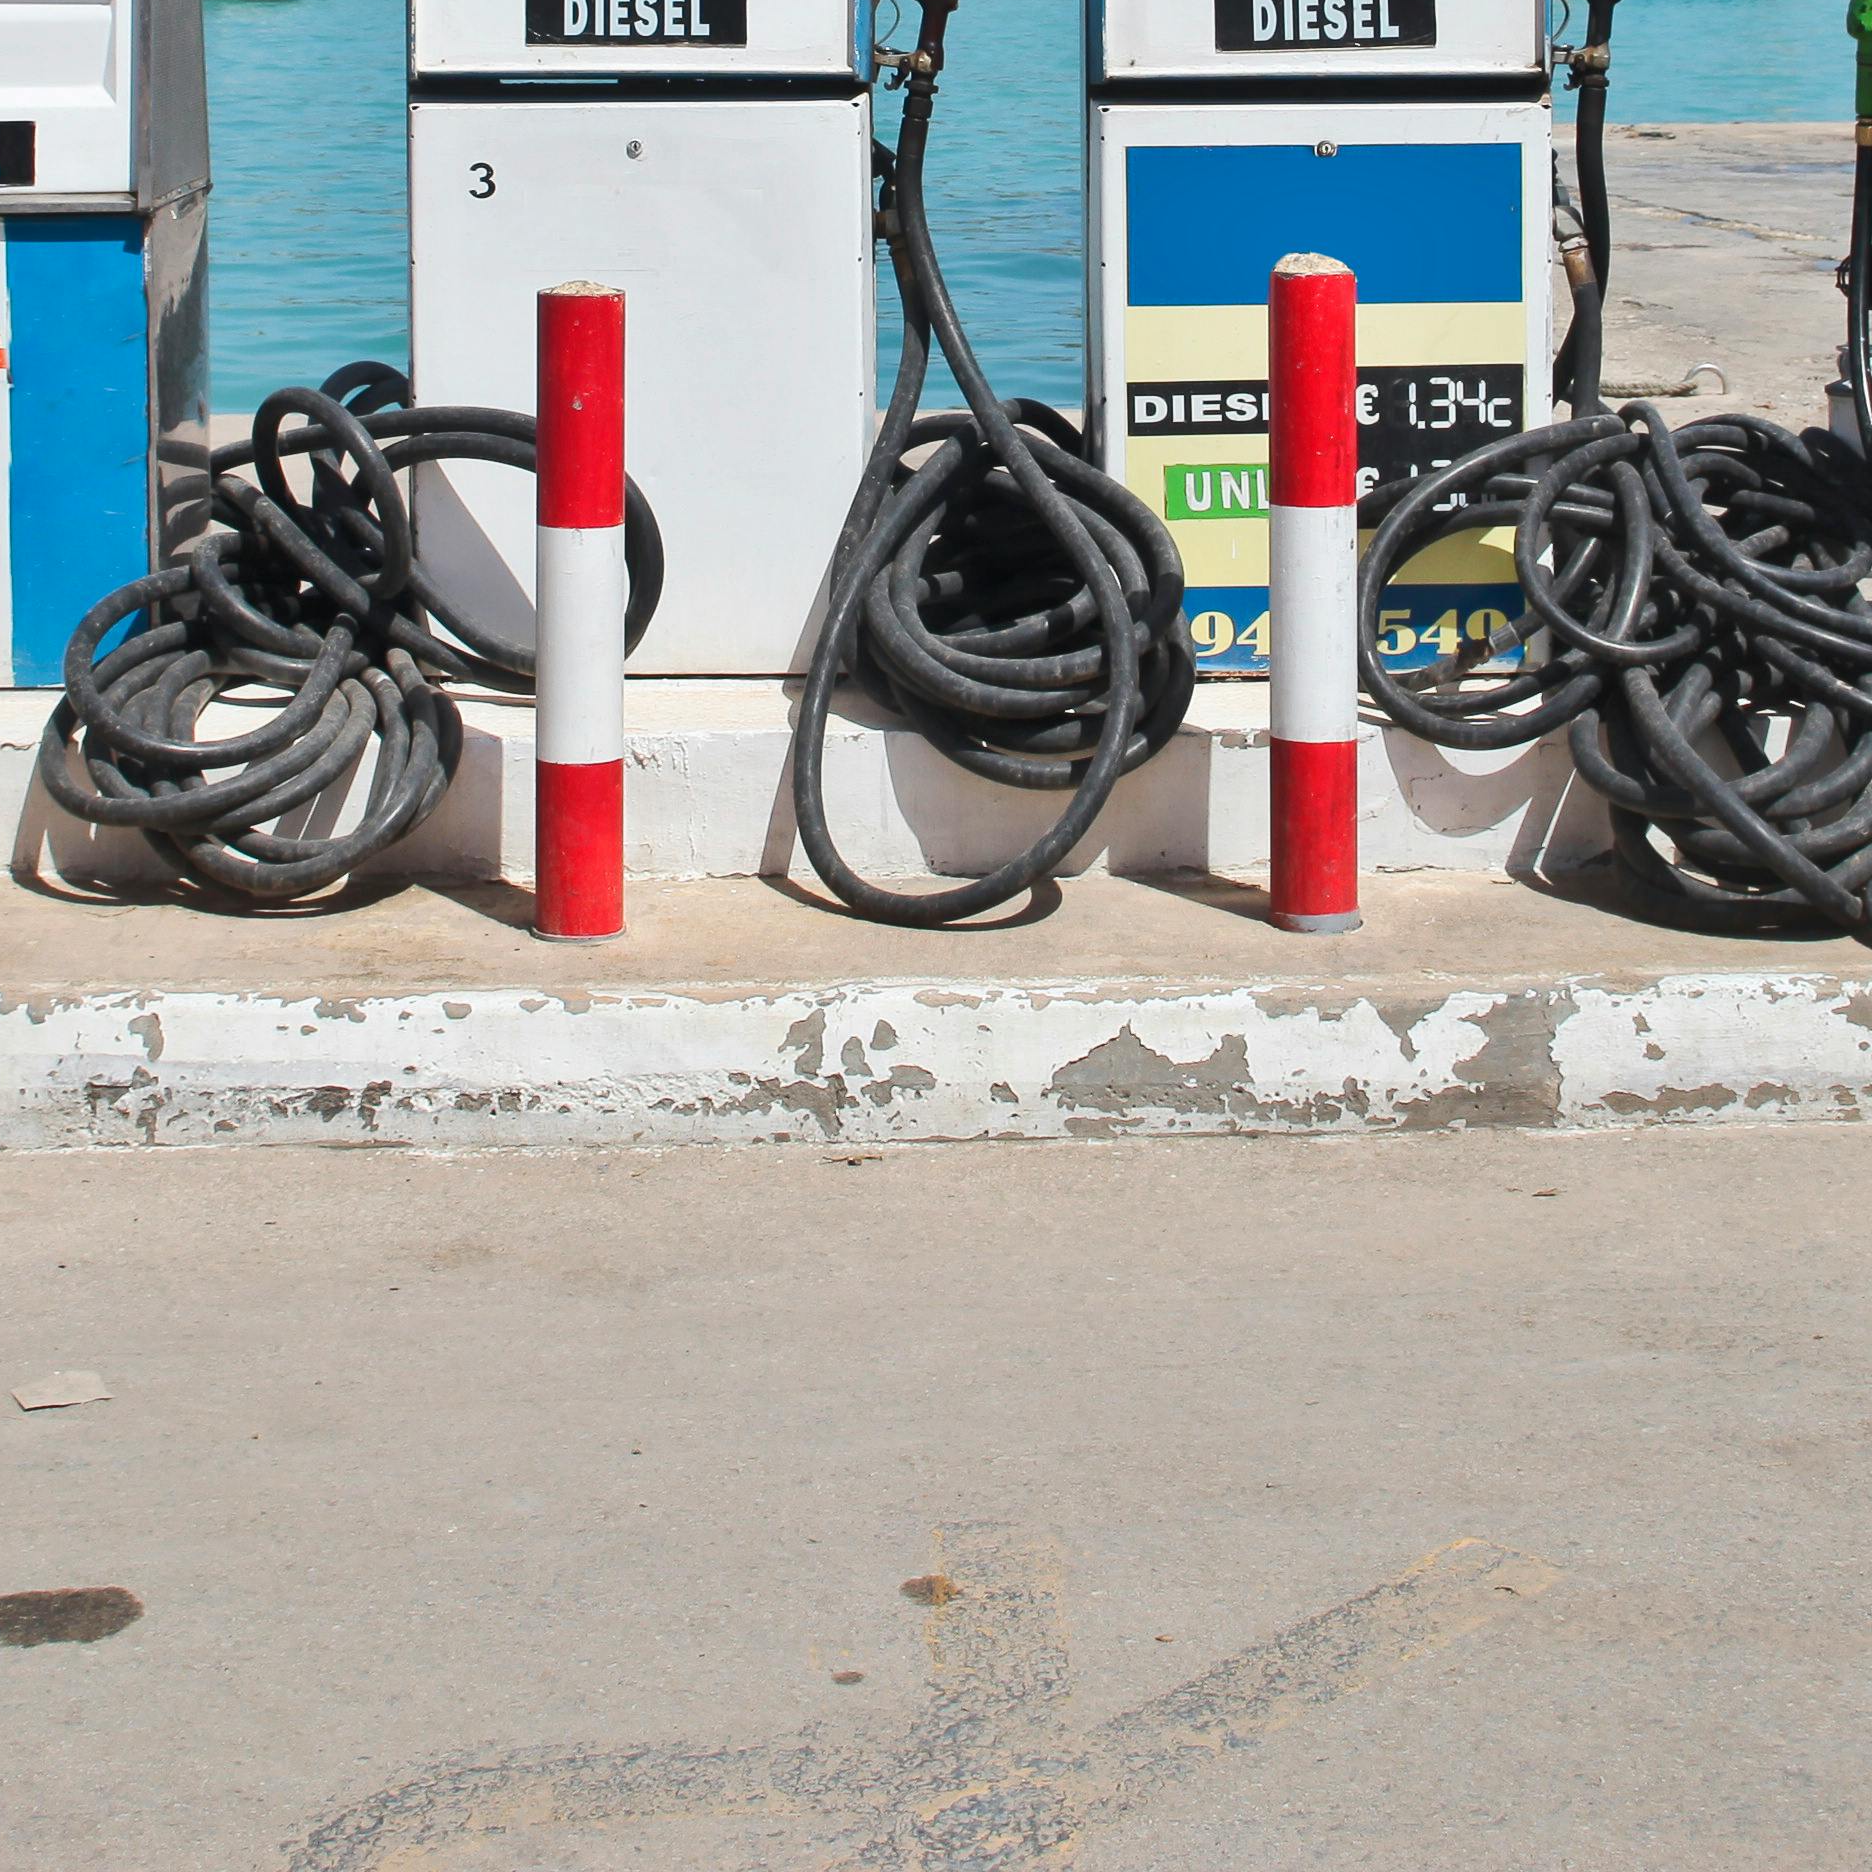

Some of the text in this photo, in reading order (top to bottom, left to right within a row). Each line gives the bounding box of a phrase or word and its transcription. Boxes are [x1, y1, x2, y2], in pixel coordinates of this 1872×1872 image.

[468, 161, 496, 199] 3
[1134, 392, 1270, 424] DIES
[1355, 383, 1380, 426] €
[1184, 468, 1270, 513] UNL
